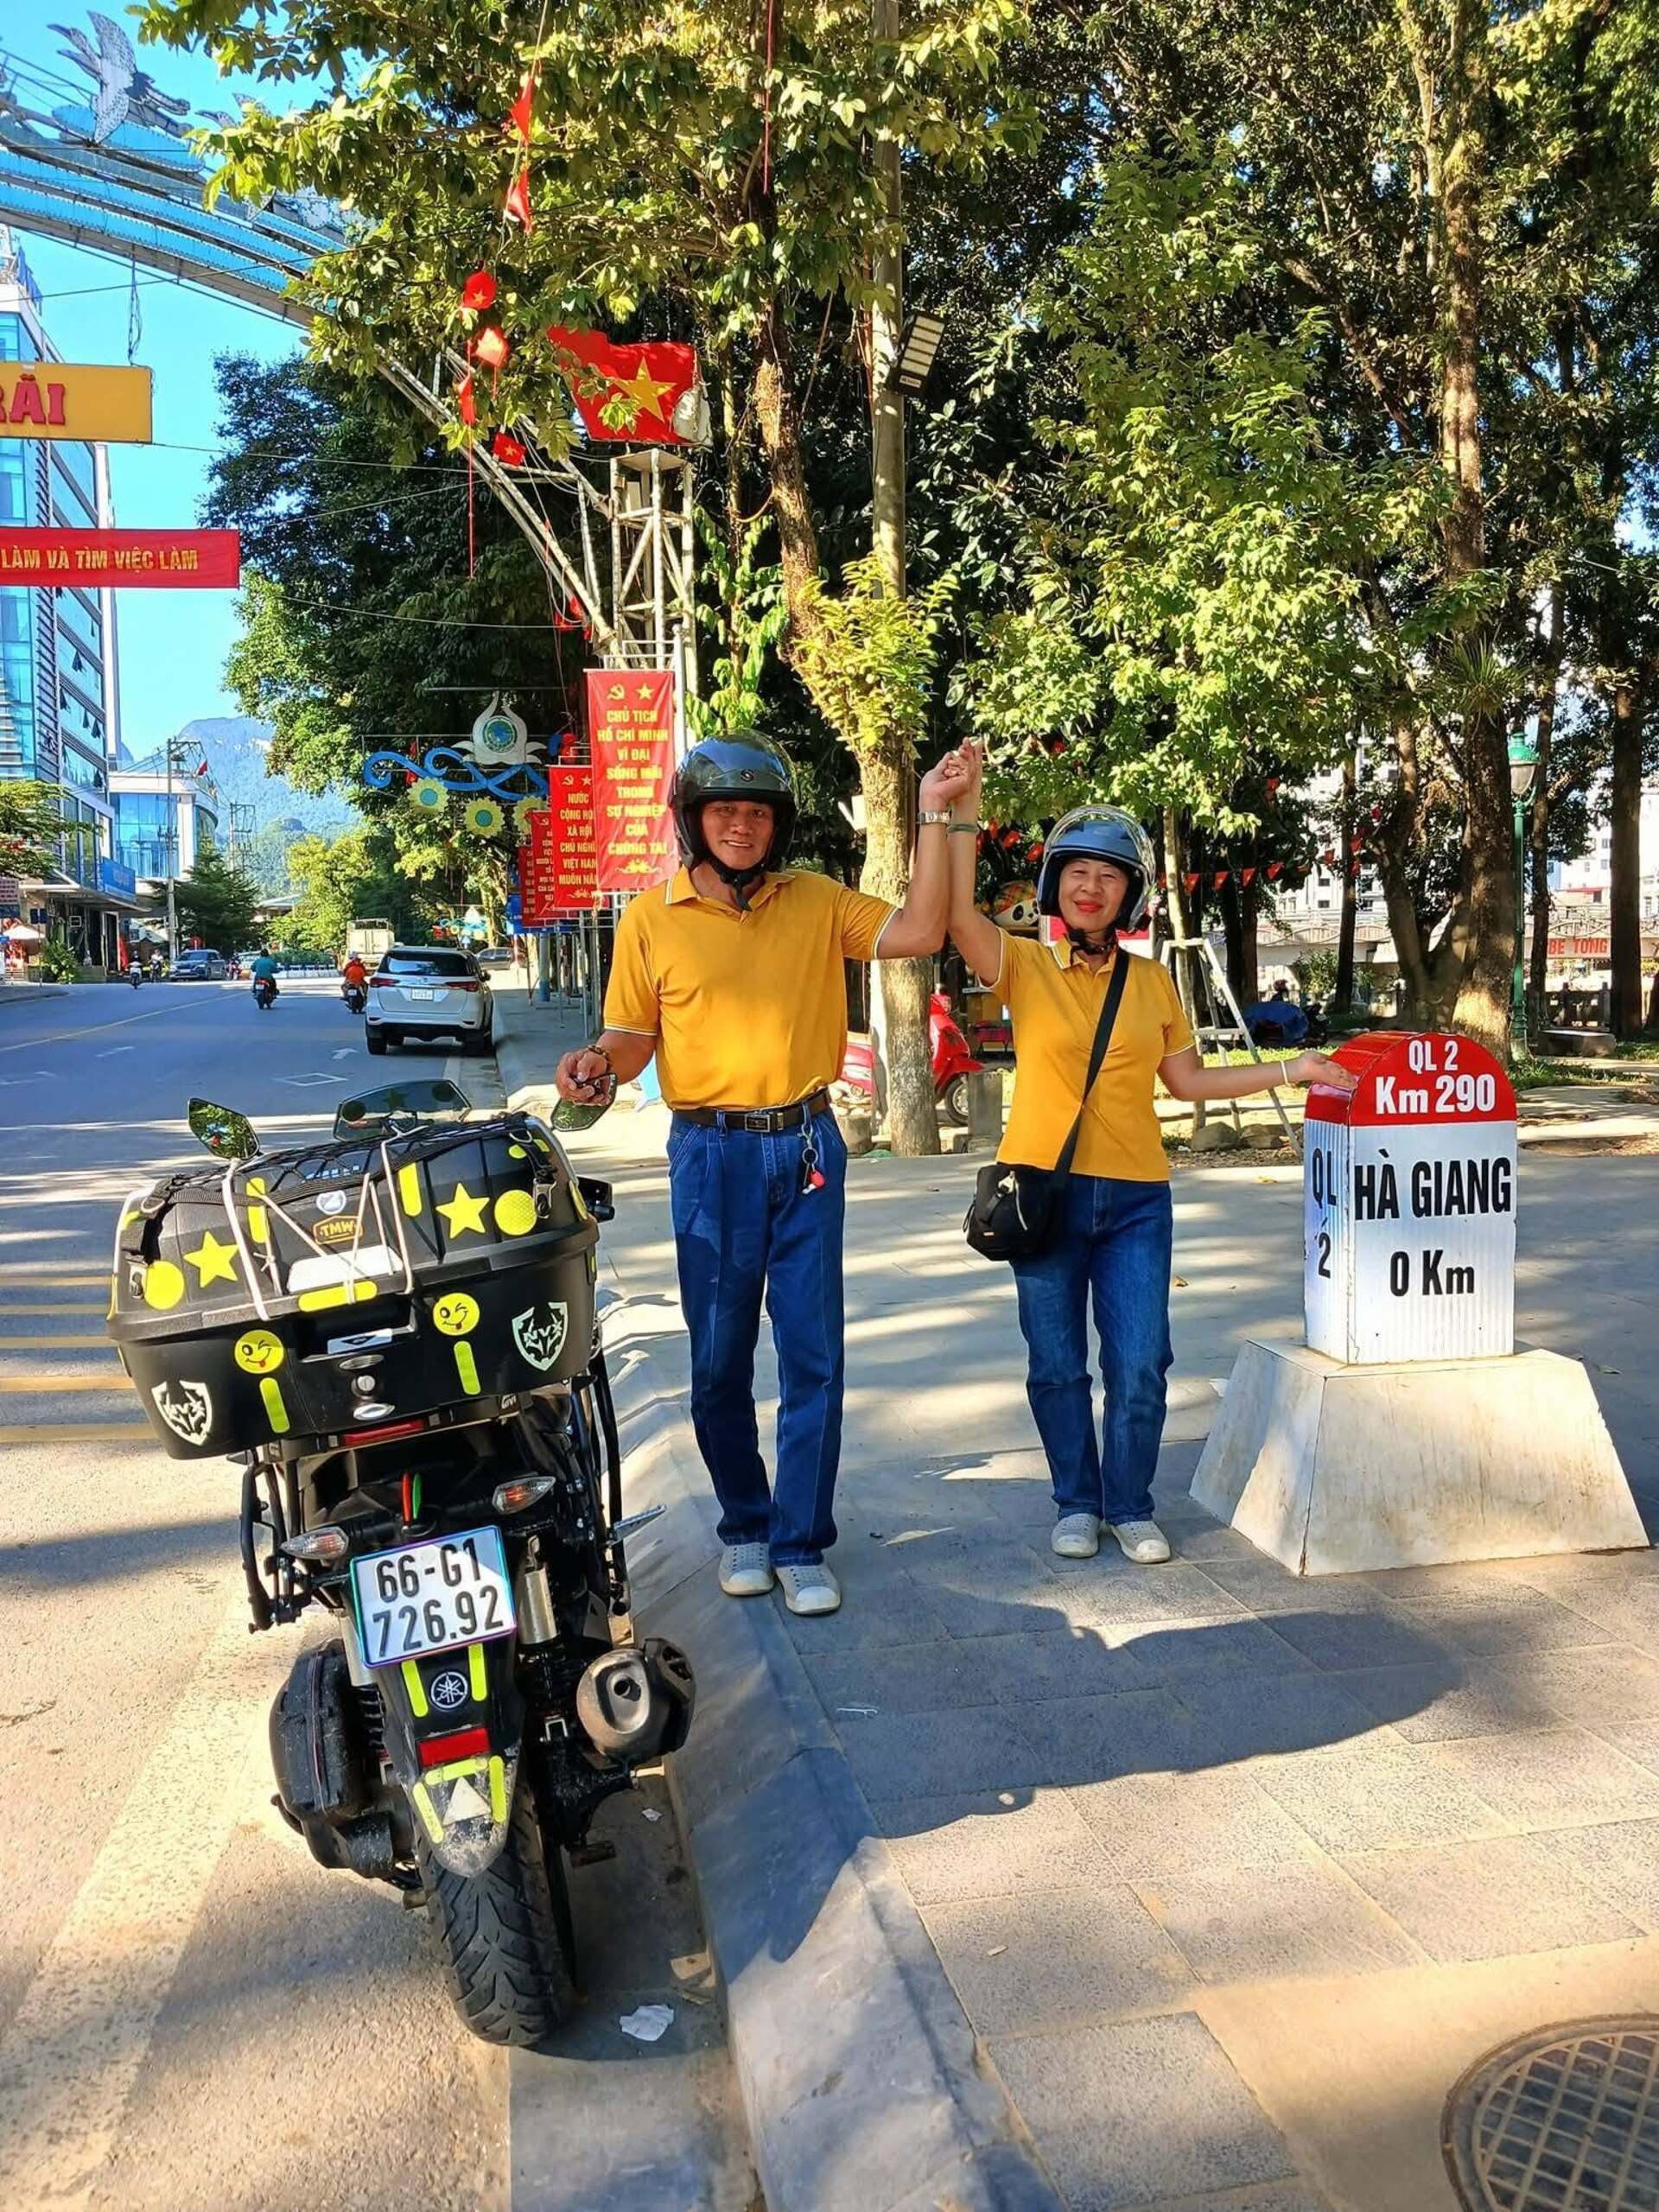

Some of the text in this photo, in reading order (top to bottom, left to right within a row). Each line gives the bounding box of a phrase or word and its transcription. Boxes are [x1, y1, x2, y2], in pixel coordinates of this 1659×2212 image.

[0, 373, 66, 425] ÃI
[1, 545, 199, 574] LÀM VÀ TÌM VIỆC LÀM
[1408, 1039, 1459, 1073] QL 2
[1375, 1074, 1496, 1115] Km 290
[1312, 1147, 1338, 1210] QL
[1354, 1148, 1512, 1221] HÀ GIANG
[1318, 1232, 1331, 1279] 2
[1421, 1249, 1475, 1295] Km
[376, 1538, 481, 1603] 66-G1
[372, 1585, 503, 1658] 726.92
